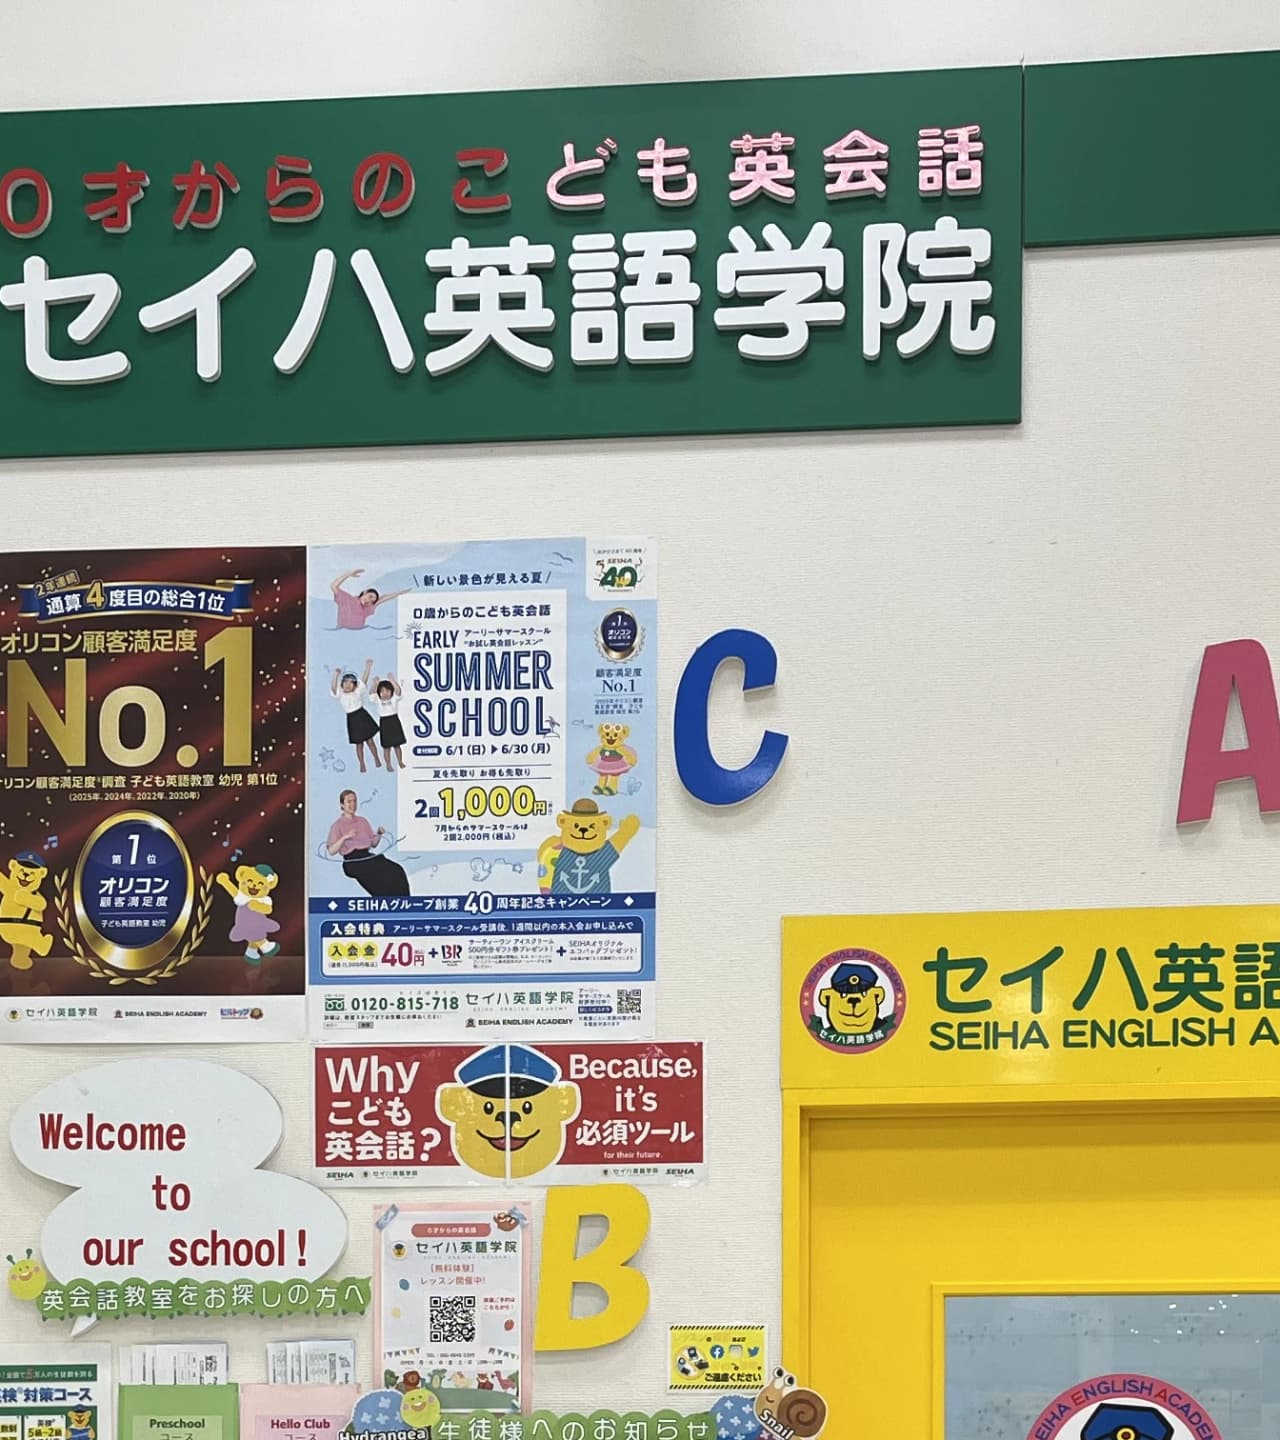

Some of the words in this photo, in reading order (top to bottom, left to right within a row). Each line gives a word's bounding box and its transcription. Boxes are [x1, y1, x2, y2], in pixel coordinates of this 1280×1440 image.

[423, 571, 543, 586] 新しい景色が見える夏
[45, 579, 225, 614] 通算4度目の総合1位
[413, 604, 551, 619] 0歳からのこども英会話
[0, 629, 197, 654] オリコン顧客満足度
[412, 630, 460, 649] EARLY
[412, 650, 554, 692] SUMMER
[6, 626, 253, 768] No.1
[602, 679, 635, 693] No.1
[412, 696, 552, 738] SCHOOL
[673, 628, 790, 808] C
[98, 877, 170, 895] オリコン
[99, 896, 168, 908] 顧客満足度
[330, 923, 385, 936] 入会特典
[351, 996, 459, 1011] 0120-815-718
[465, 991, 574, 1005] セイハ英語学院
[929, 1019, 1050, 1052] SEIHA
[1063, 1016, 1236, 1049] ENGLISH
[325, 1057, 420, 1095] Why
[569, 1053, 698, 1080] Because,
[327, 1097, 411, 1127] こども
[38, 1113, 187, 1151] Welcome
[324, 1128, 442, 1162] 英会話?
[576, 1119, 696, 1147] 必須ツール
[603, 1151, 615, 1159] for
[615, 1151, 636, 1159] their
[152, 1174, 191, 1211] to
[82, 1238, 144, 1266] our
[416, 1241, 518, 1254] セイハ英語学院
[534, 1183, 652, 1352] B
[42, 1283, 365, 1312] 英会話教室をお探しの方へ
[1070, 1379, 1154, 1407] ENGLISH
[149, 1418, 206, 1430] Preschool
[271, 1418, 301, 1430] Hello
[304, 1418, 331, 1430] Club
